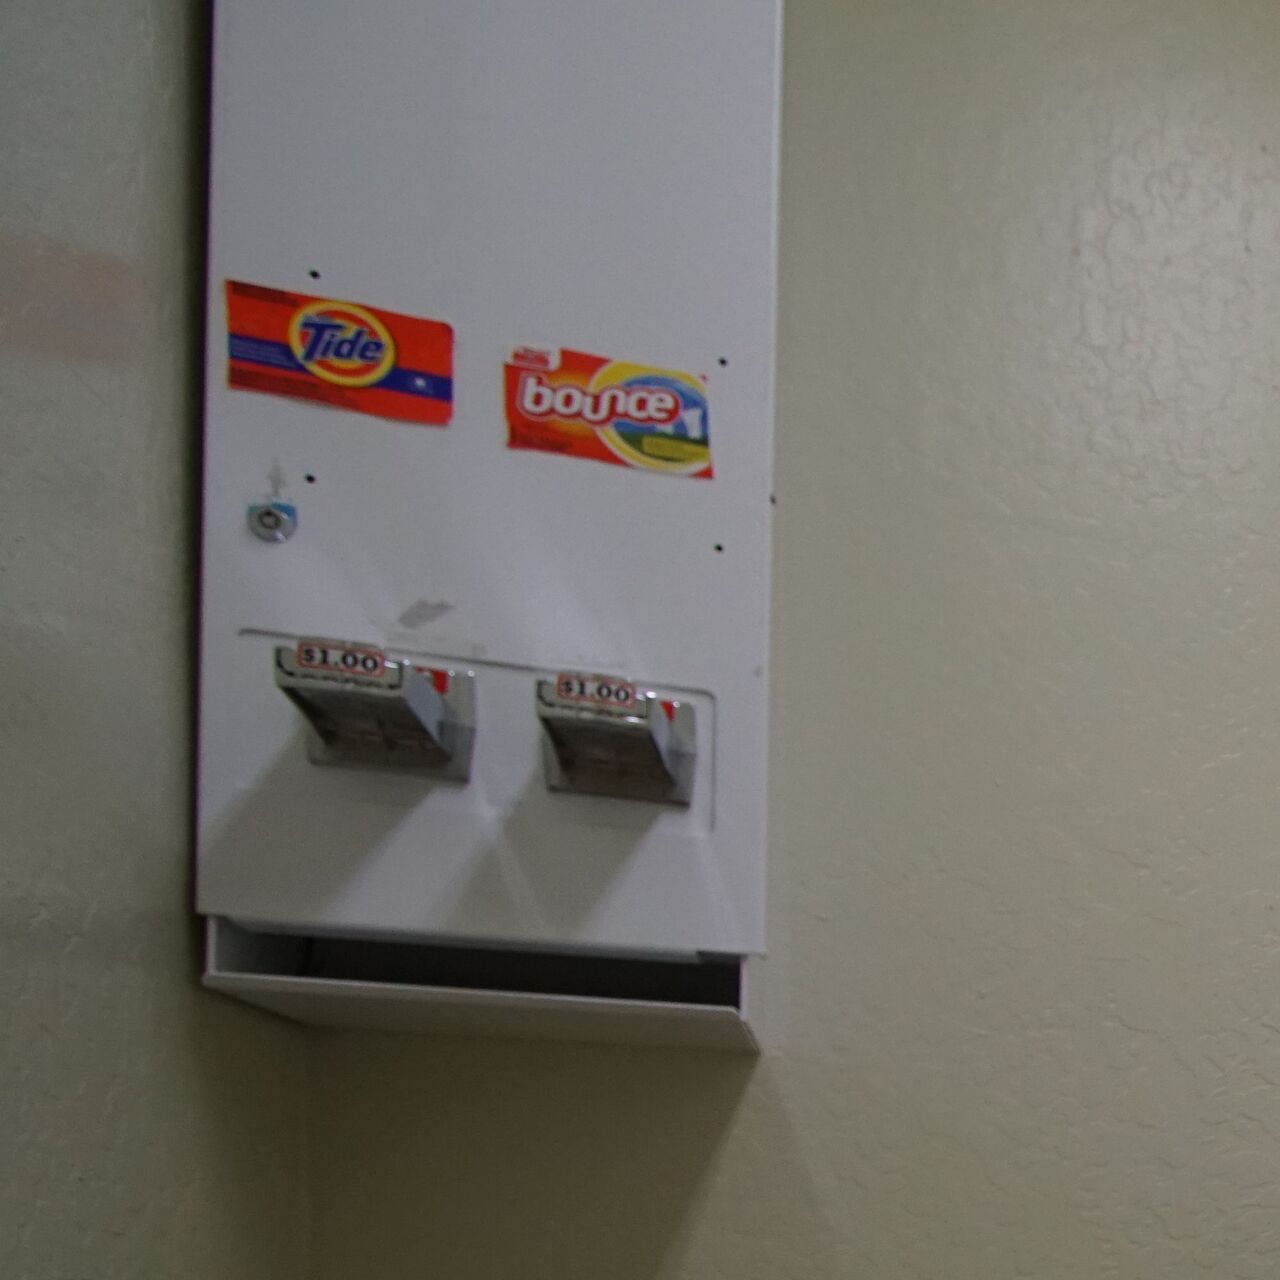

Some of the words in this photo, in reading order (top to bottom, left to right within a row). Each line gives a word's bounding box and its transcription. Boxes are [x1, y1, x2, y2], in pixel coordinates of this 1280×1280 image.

[301, 320, 386, 363] Tide
[523, 375, 676, 422] bounce
[302, 647, 378, 672] $1.00
[560, 679, 630, 702] $1.00
